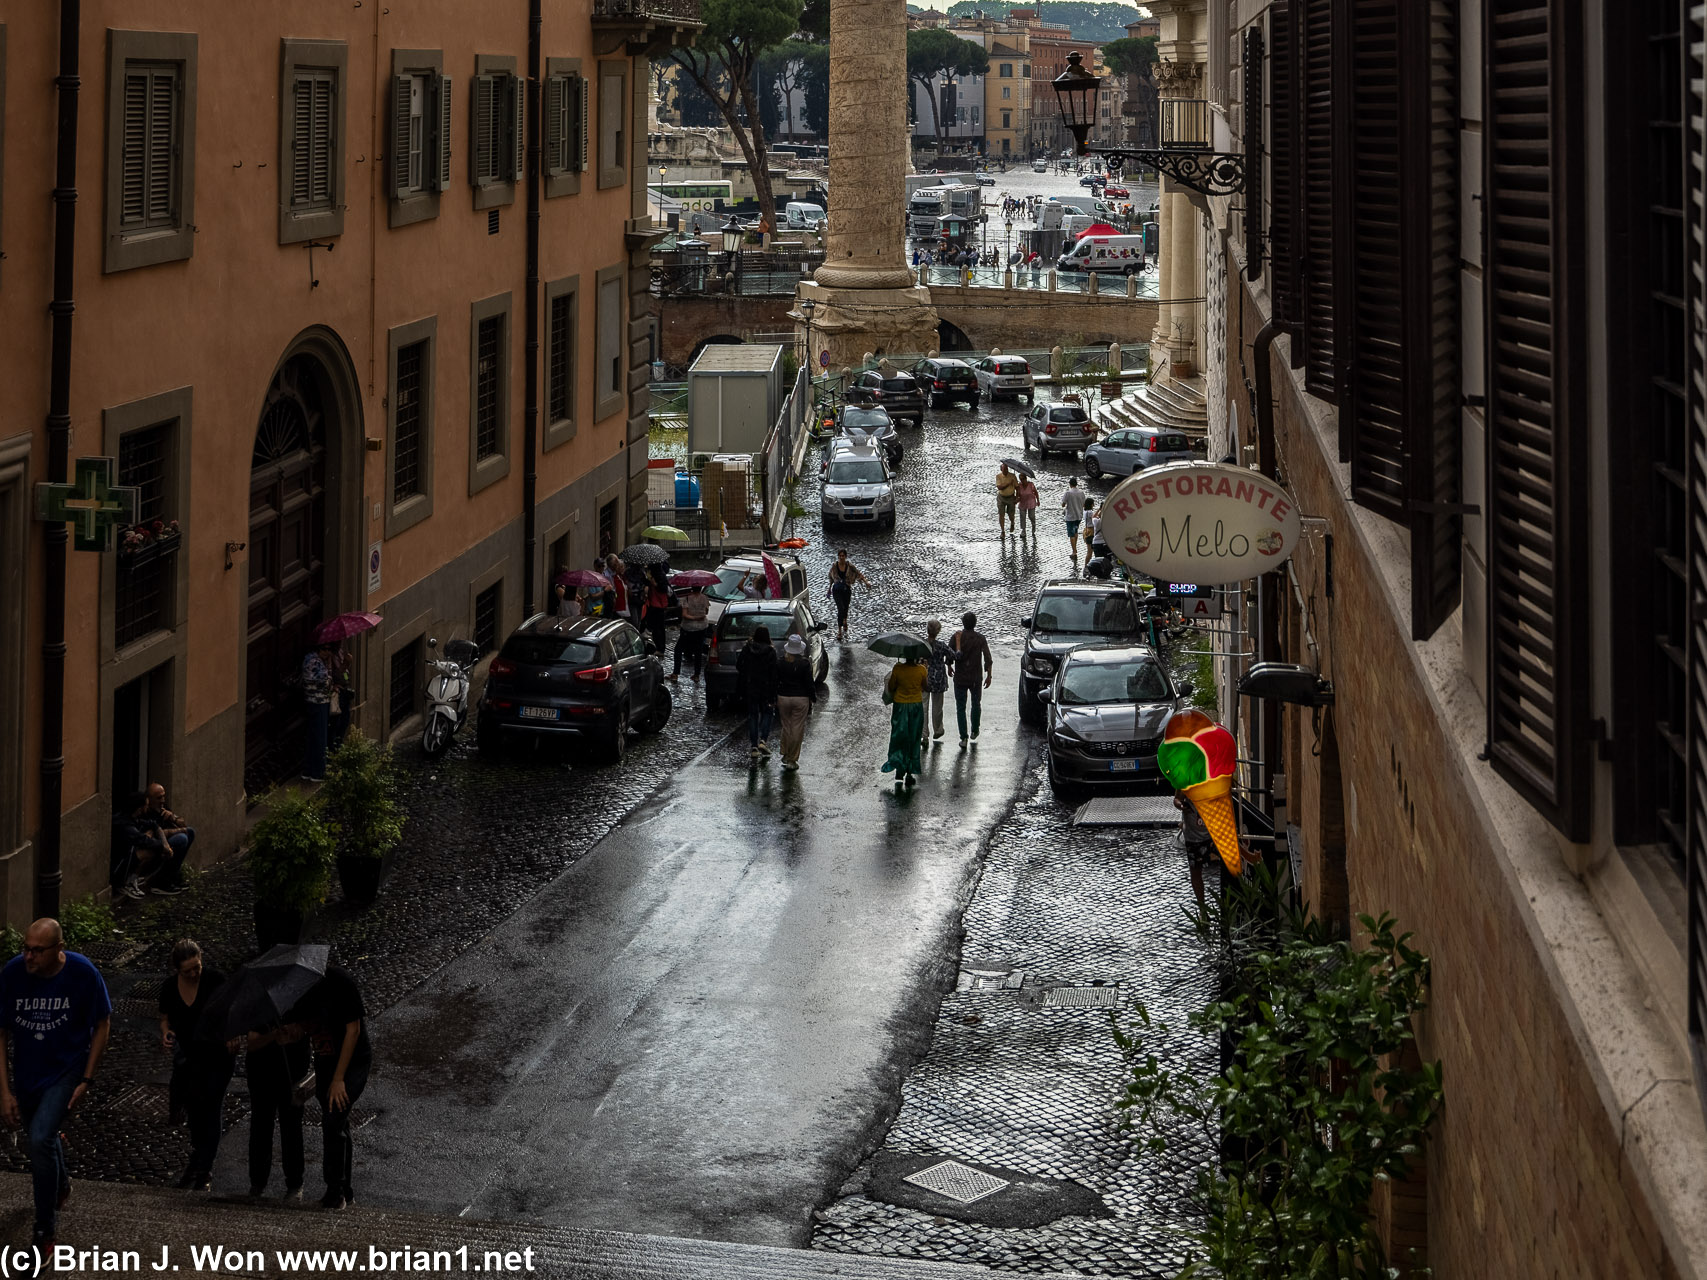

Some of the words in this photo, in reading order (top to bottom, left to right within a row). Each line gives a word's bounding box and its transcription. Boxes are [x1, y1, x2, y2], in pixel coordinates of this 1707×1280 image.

[682, 200, 712, 212] ado
[1113, 475, 1291, 522] RISTORANTE
[1157, 514, 1249, 562] Melo
[1169, 583, 1197, 593] SHOP
[1194, 600, 1208, 614] A
[15, 996, 70, 1010] FLORIDA
[15, 1013, 68, 1031] UNIVERSITY
